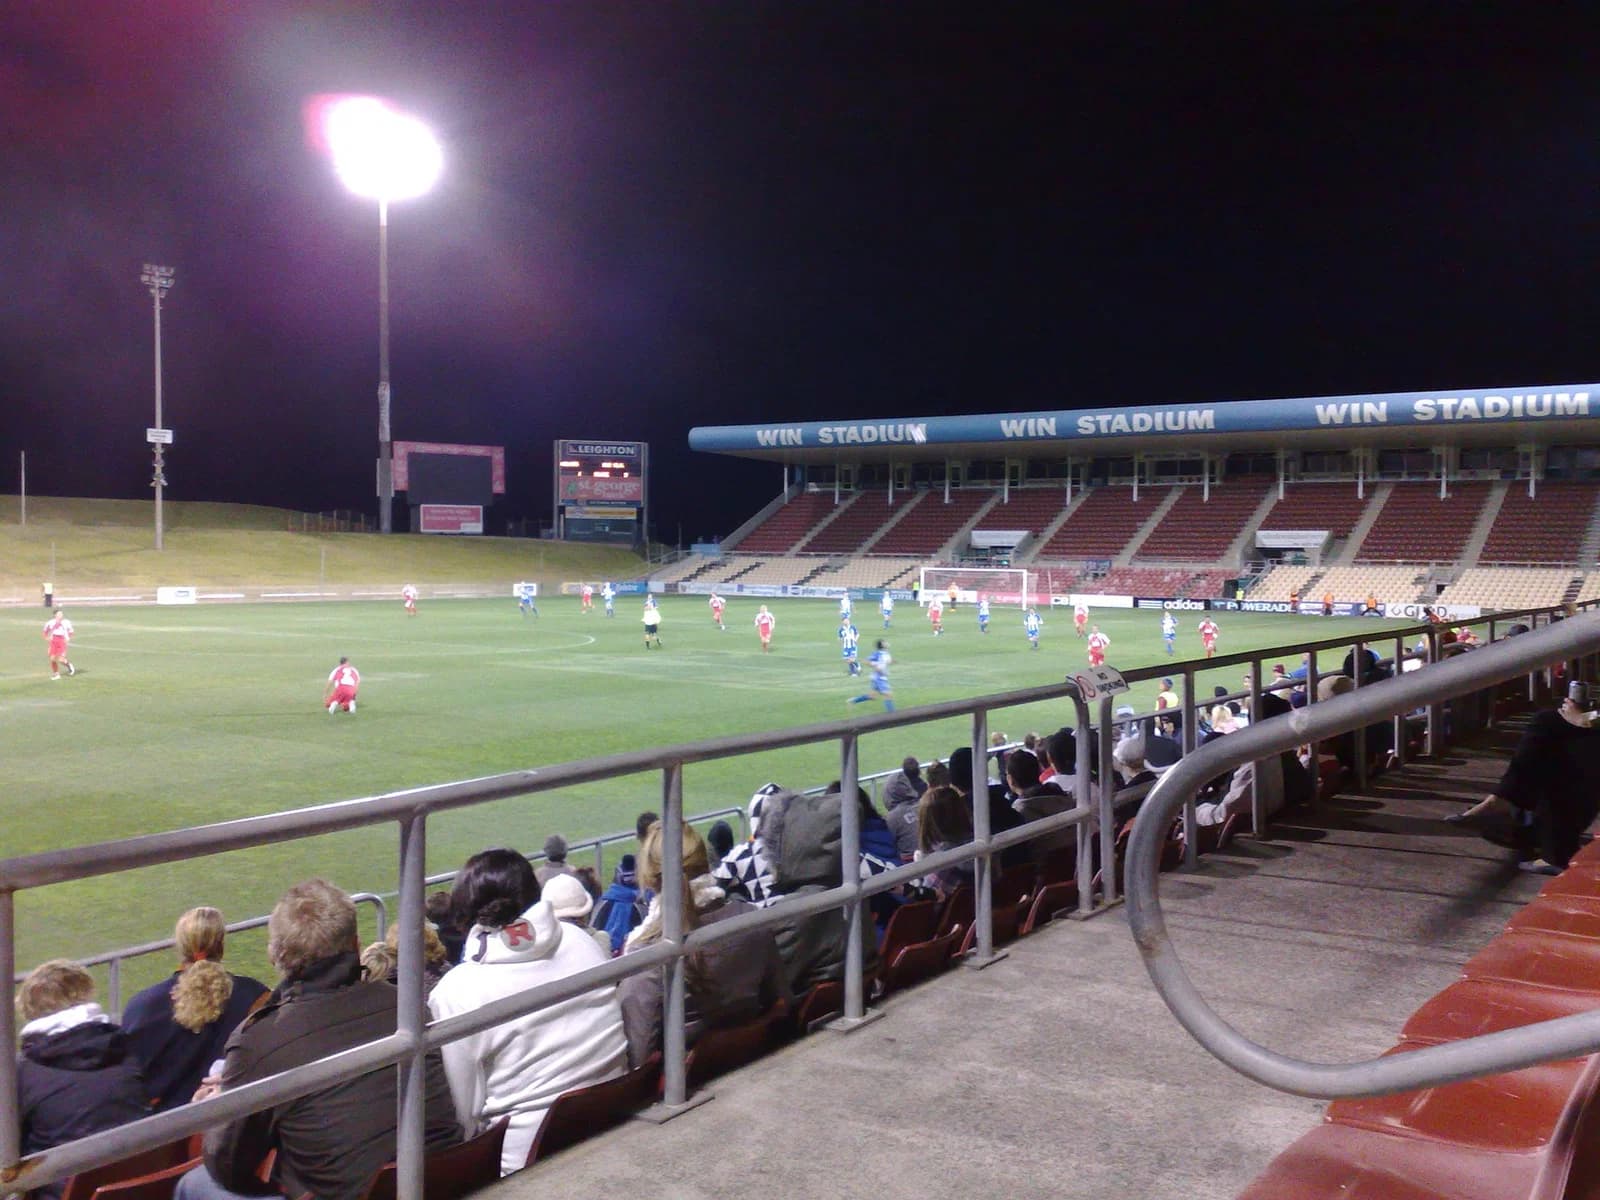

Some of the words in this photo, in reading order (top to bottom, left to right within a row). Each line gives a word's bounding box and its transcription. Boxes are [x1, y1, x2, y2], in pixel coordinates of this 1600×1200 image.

[1315, 402, 1388, 425] WIN
[1413, 393, 1590, 421] STADIUM
[1000, 417, 1057, 438] WIN
[1077, 409, 1216, 435] STADIUM
[756, 428, 803, 446] WIN
[818, 423, 927, 445] STADIUM
[578, 445, 635, 455] LEIGHTON
[1163, 599, 1205, 610] adidas
[1226, 601, 1297, 613] PWERAD
